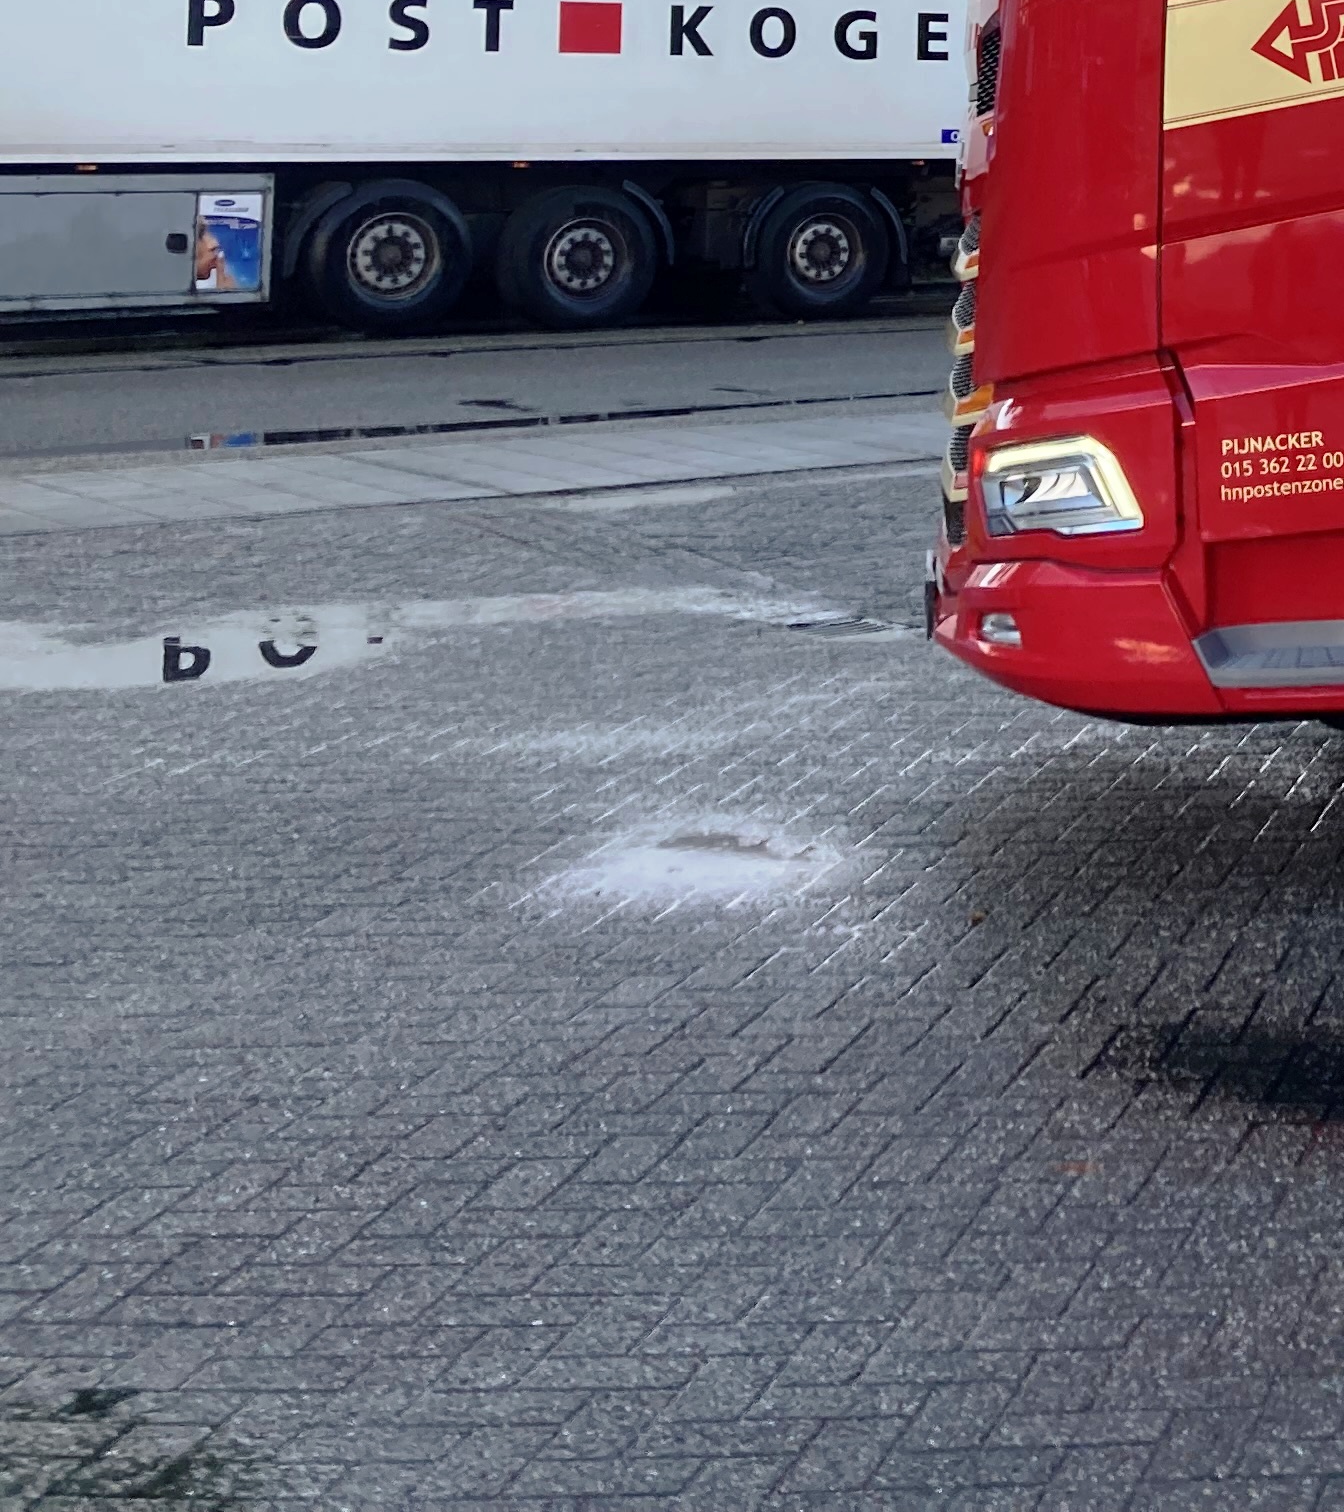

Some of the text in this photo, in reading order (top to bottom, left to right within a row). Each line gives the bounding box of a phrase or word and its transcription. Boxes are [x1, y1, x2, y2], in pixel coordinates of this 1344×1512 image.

[1221, 430, 1324, 456] PIJNACKER
[1221, 451, 1344, 478] 015 362 22 00
